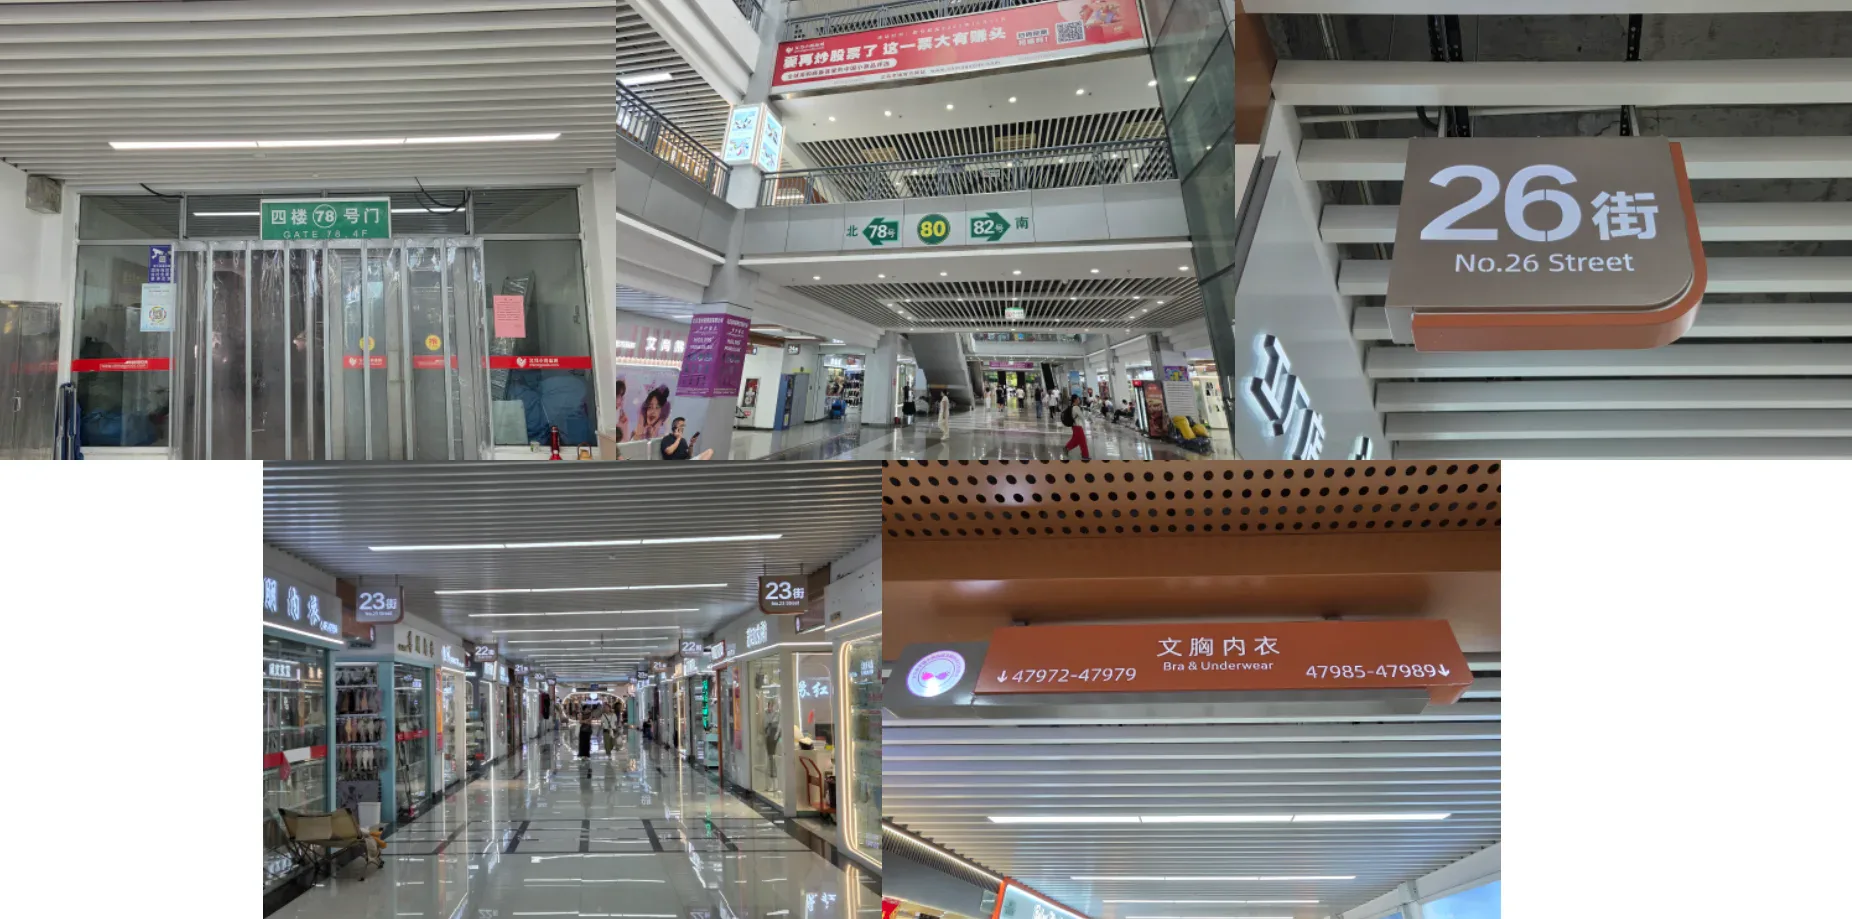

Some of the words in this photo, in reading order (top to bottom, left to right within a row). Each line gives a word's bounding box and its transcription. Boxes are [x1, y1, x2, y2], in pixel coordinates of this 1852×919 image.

[1421, 164, 1658, 242] 26街
[283, 230, 319, 240] GATE
[352, 229, 368, 238] 4F
[846, 224, 858, 237] 北
[868, 224, 896, 239] 78号
[920, 220, 946, 238] 80
[973, 219, 1004, 235] 82号
[1015, 216, 1029, 230] 南
[1455, 253, 1539, 272] No.26
[1549, 253, 1634, 272] Street
[765, 581, 804, 600] 23街
[359, 592, 397, 610] 23街
[1157, 635, 1280, 657] 文胸内衣
[1163, 661, 1185, 671] Bra
[1188, 661, 1198, 671] &
[1201, 660, 1274, 671] Underwear
[1306, 663, 1437, 679] 47985-47989
[1012, 667, 1137, 683] 47972-47979
